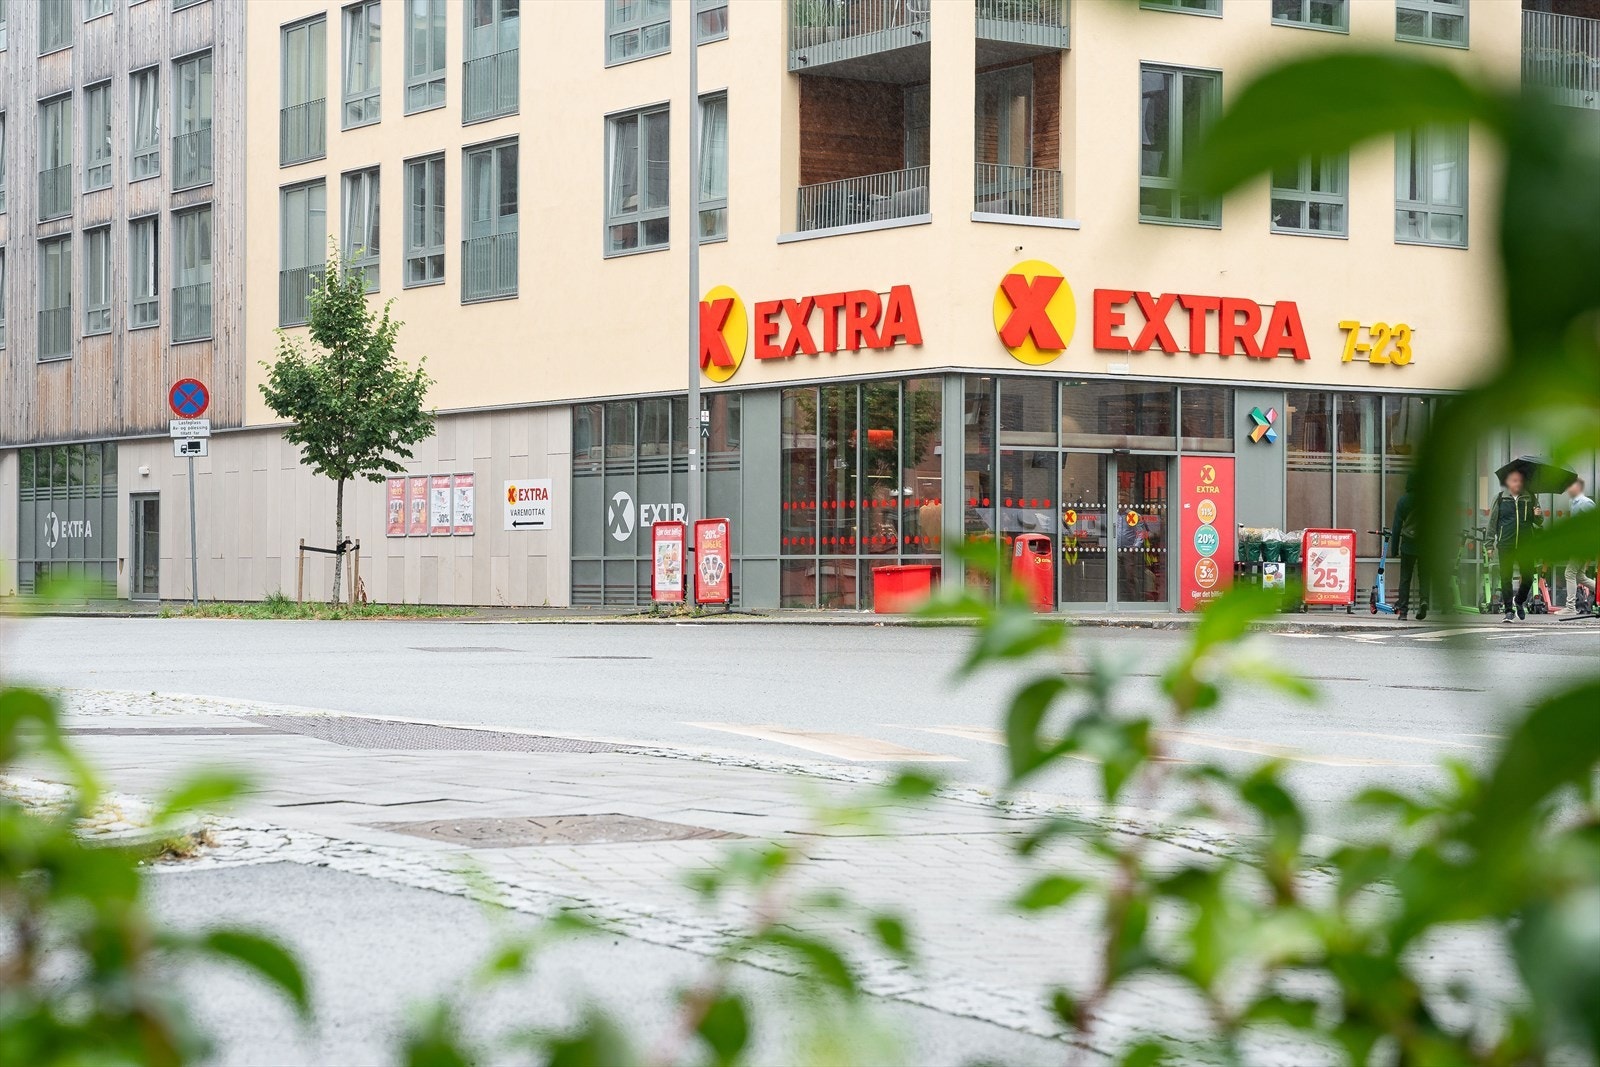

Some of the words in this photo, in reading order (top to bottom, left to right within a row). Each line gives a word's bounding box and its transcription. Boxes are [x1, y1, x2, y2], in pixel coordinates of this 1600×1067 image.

[754, 284, 923, 360] EXTRA
[999, 273, 1067, 350] X
[1093, 288, 1311, 361] EXTRA
[1338, 320, 1413, 366] 7-23
[518, 487, 549, 501] EXTRA
[1196, 485, 1220, 494] EXTRA
[510, 508, 546, 517] VAREMOTTAK
[640, 503, 688, 527] EXTR
[1200, 507, 1213, 517] 11%
[61, 520, 93, 538] EXTRA
[1197, 533, 1216, 545] 20%
[1199, 565, 1214, 579] 3%
[1313, 567, 1345, 590] 25,-
